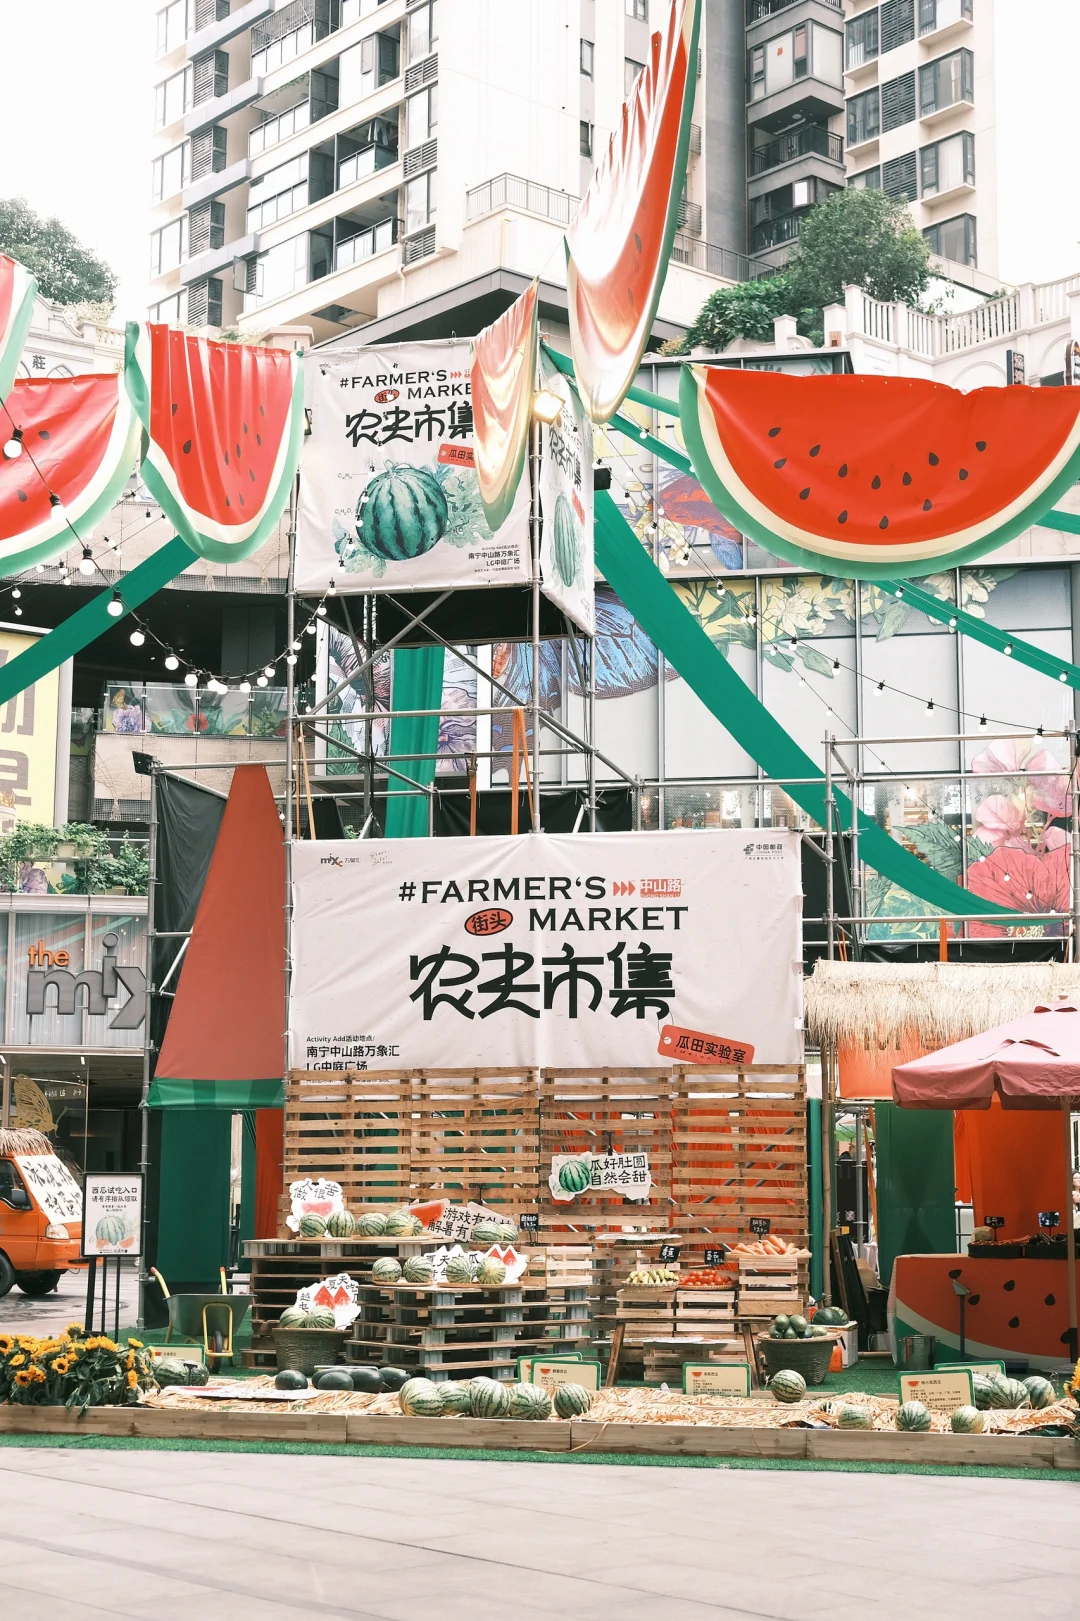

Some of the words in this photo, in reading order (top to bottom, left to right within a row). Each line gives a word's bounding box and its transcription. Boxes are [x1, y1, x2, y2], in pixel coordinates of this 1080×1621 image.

[640, 879, 682, 893] 中山路
[471, 913, 508, 933] 街头
[529, 906, 689, 931] MARKET
[28, 941, 71, 967] the
[409, 941, 676, 1020] 农夫市集
[306, 1044, 400, 1058] 南宁中山路万象汇
[676, 1036, 747, 1064] 瓜田实验室
[590, 1155, 646, 1172] 瓜好肚圆
[591, 1169, 648, 1186] 自然会甜
[91, 1186, 138, 1194] 西瓜试吃入口
[443, 1207, 512, 1226] 游戏有
[427, 1218, 476, 1240] 解暑有
